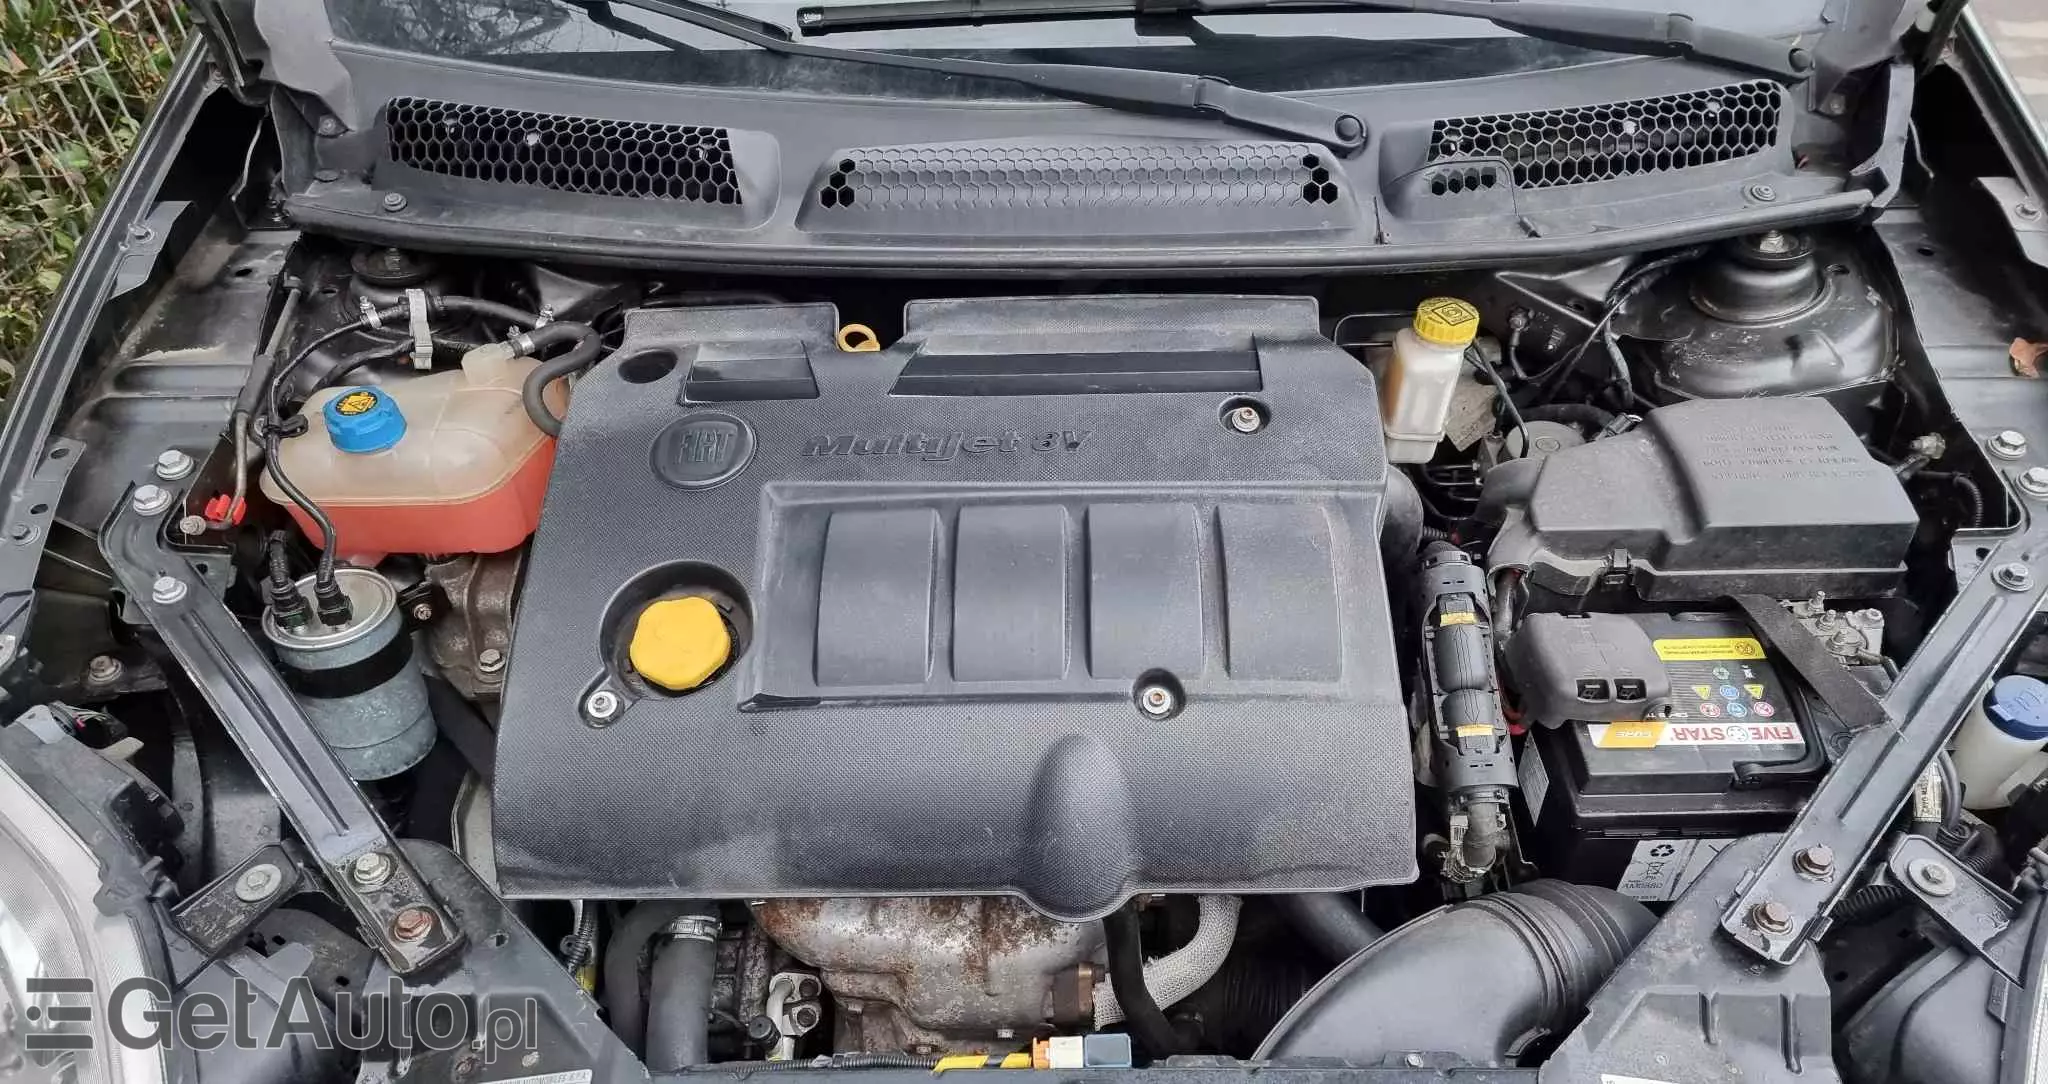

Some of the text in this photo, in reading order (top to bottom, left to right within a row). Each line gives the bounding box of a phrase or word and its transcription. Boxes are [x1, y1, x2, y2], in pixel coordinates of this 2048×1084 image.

[676, 430, 734, 466] FIAT
[1032, 431, 1093, 453] 8V
[1672, 726, 1795, 741] FIVE STAR
